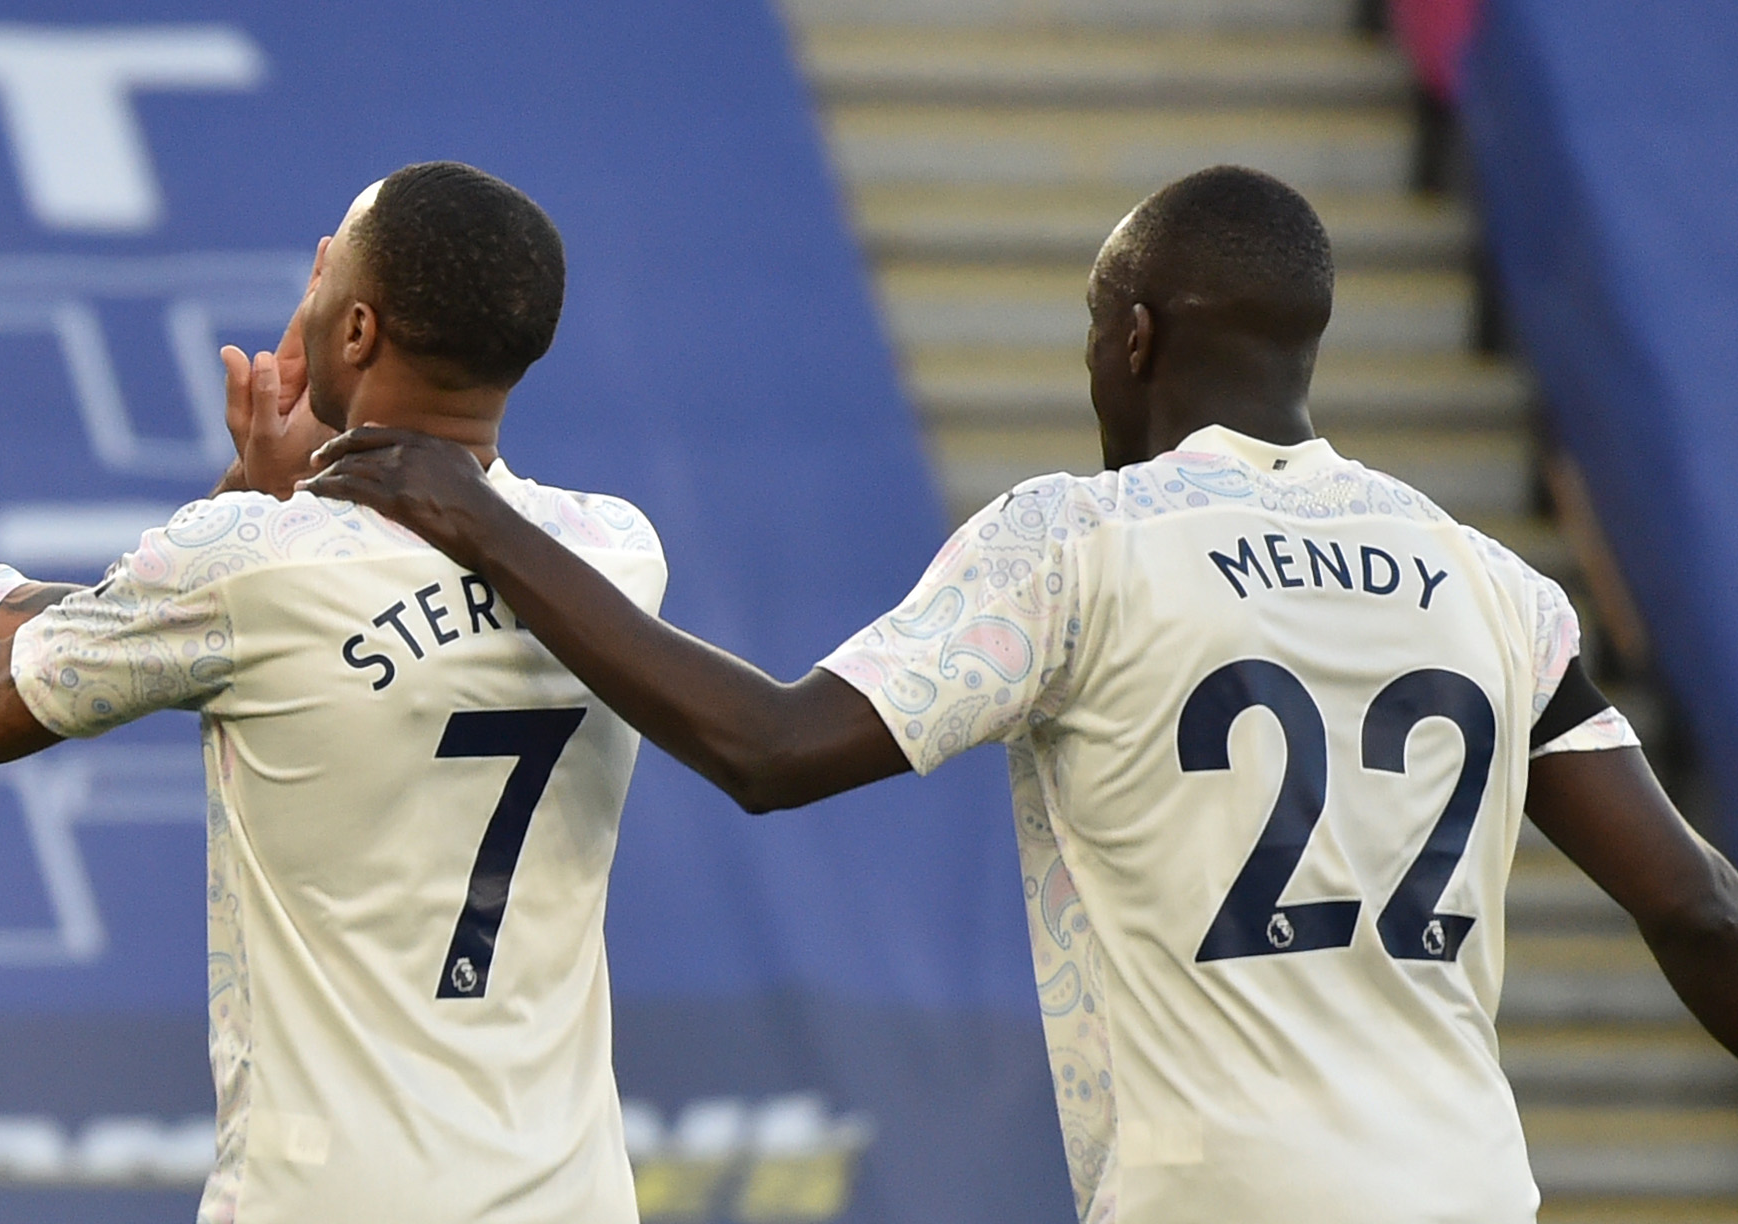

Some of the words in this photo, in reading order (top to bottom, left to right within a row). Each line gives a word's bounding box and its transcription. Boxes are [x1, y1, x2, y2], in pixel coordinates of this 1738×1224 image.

[342, 573, 531, 690] STER
[1208, 533, 1449, 611] MENDY
[433, 706, 588, 999] 7
[1176, 658, 1496, 963] 22
